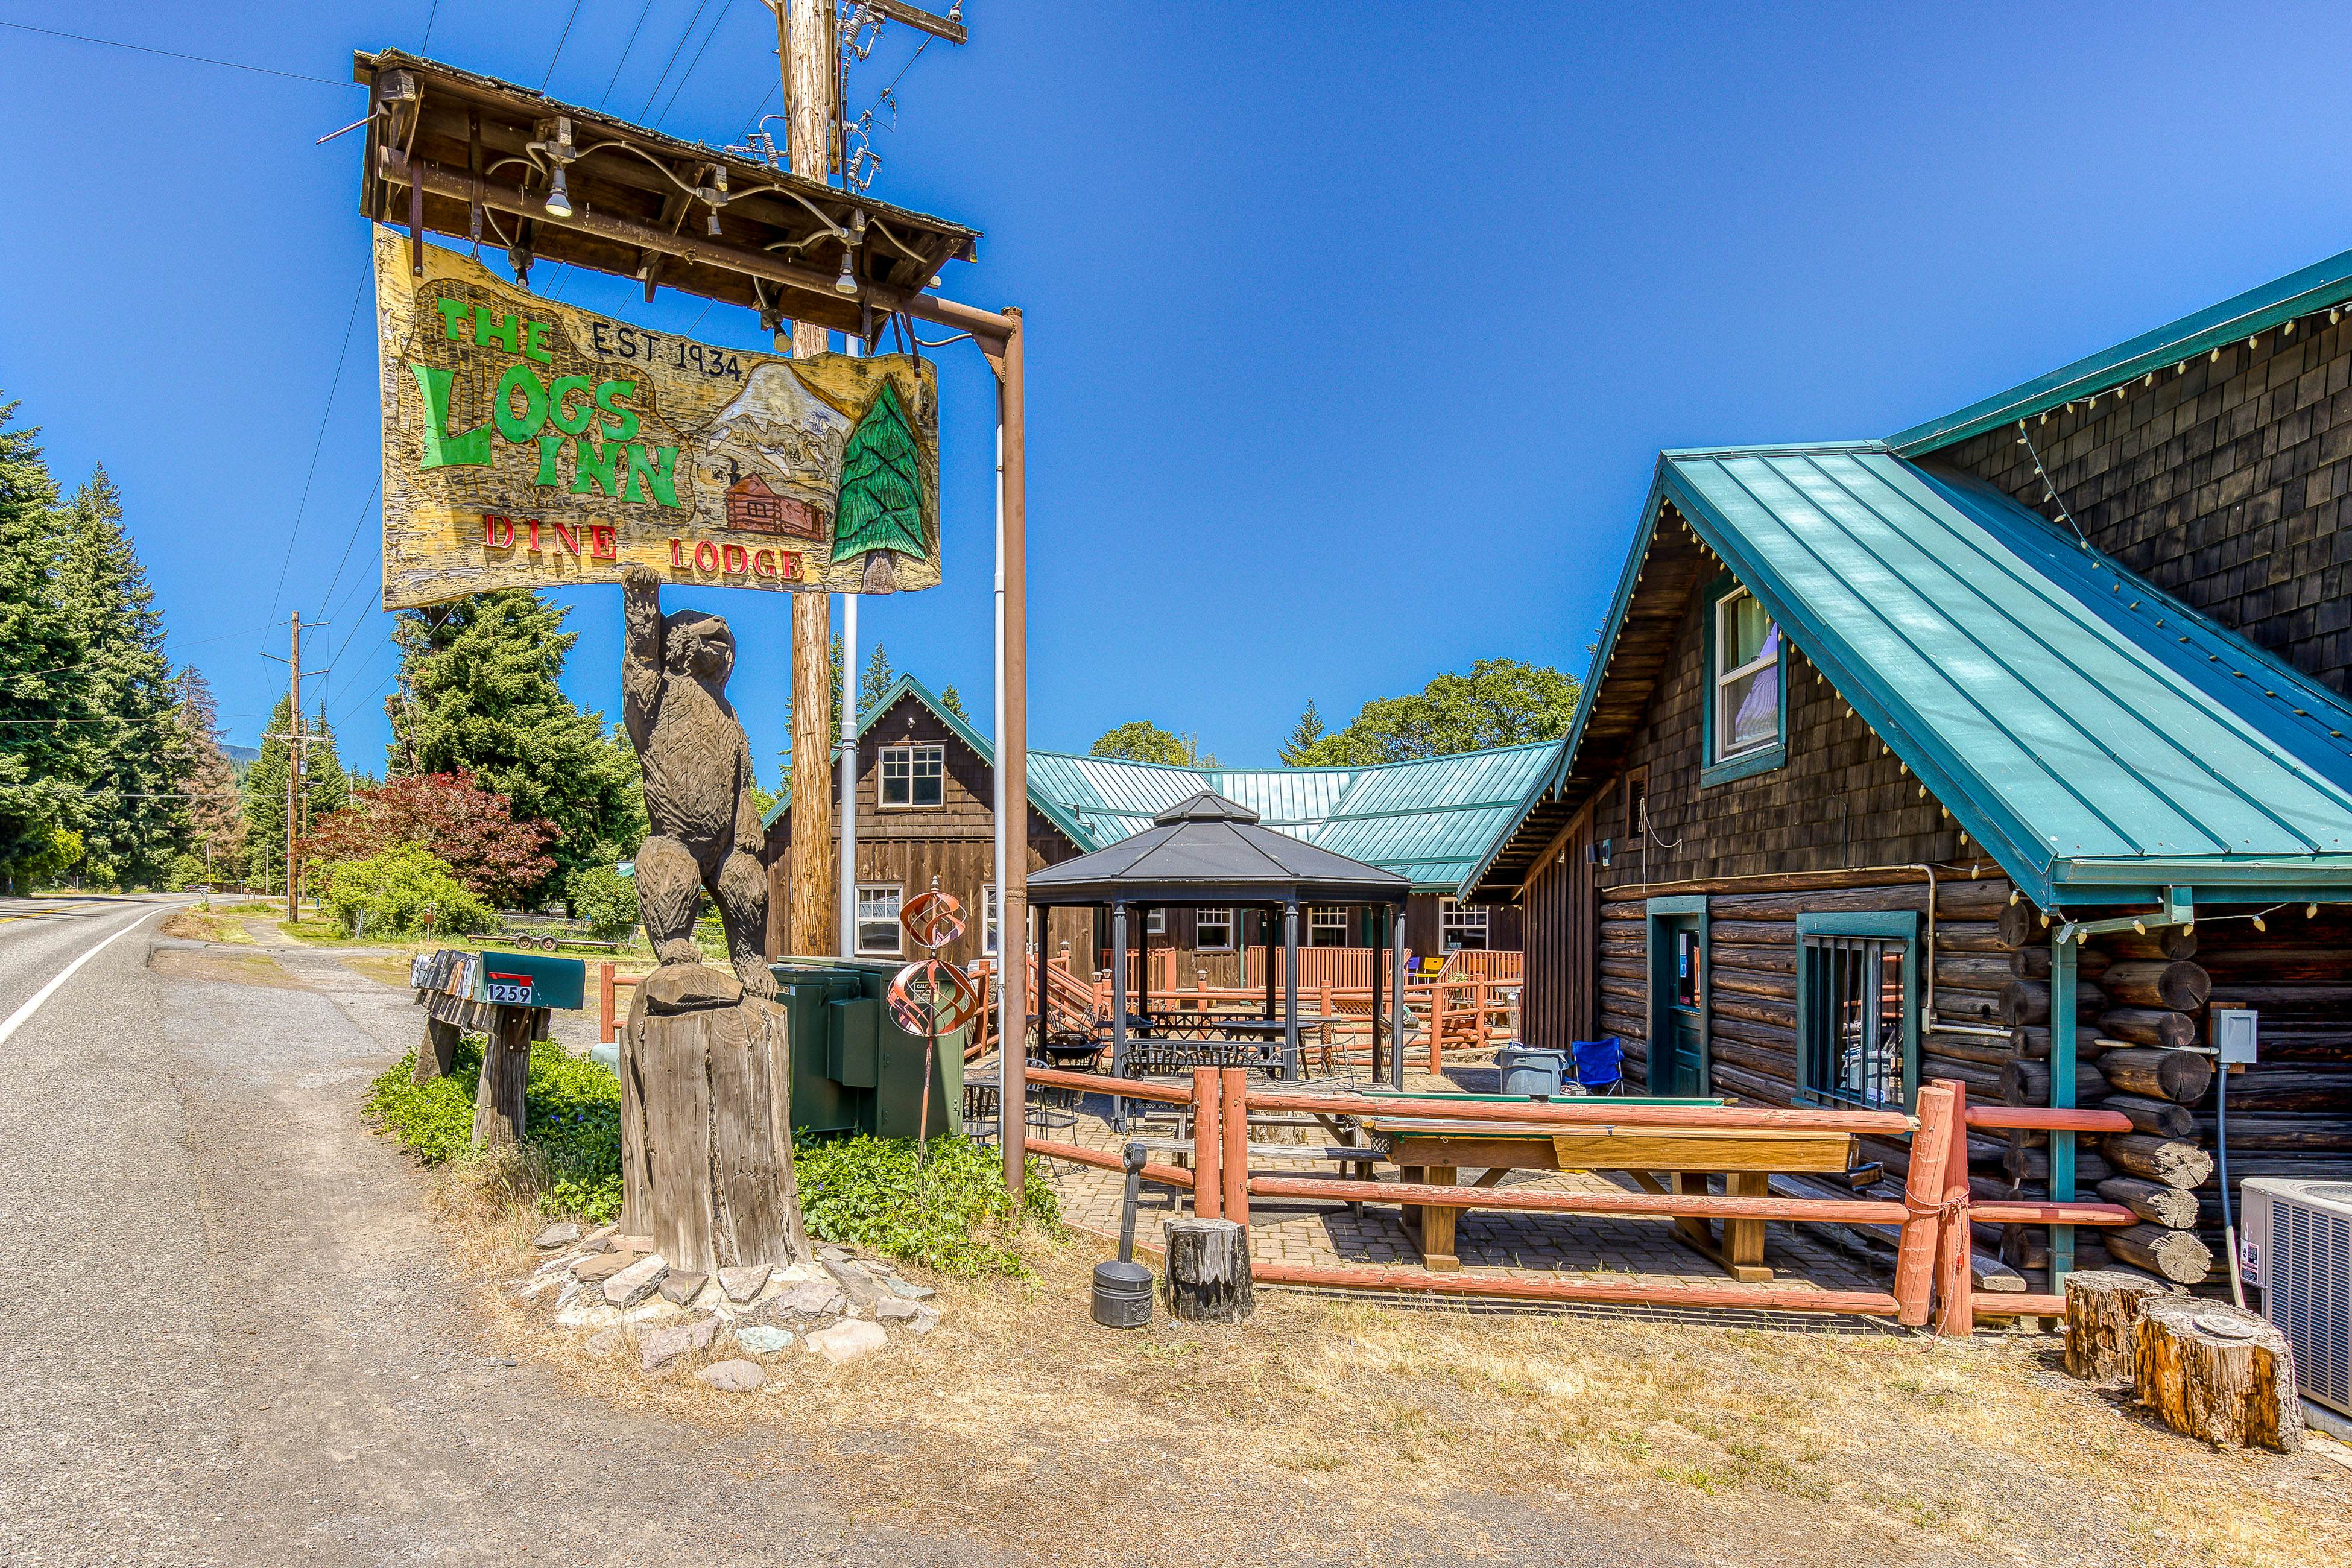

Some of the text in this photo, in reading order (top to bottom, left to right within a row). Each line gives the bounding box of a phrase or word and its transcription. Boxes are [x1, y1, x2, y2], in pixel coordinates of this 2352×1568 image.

[436, 297, 552, 364] THE
[678, 342, 742, 381] 1934
[409, 364, 640, 471] LOGS
[535, 436, 681, 509] INN
[483, 514, 805, 579] DINE LODGE
[488, 985, 530, 1002] 1259
